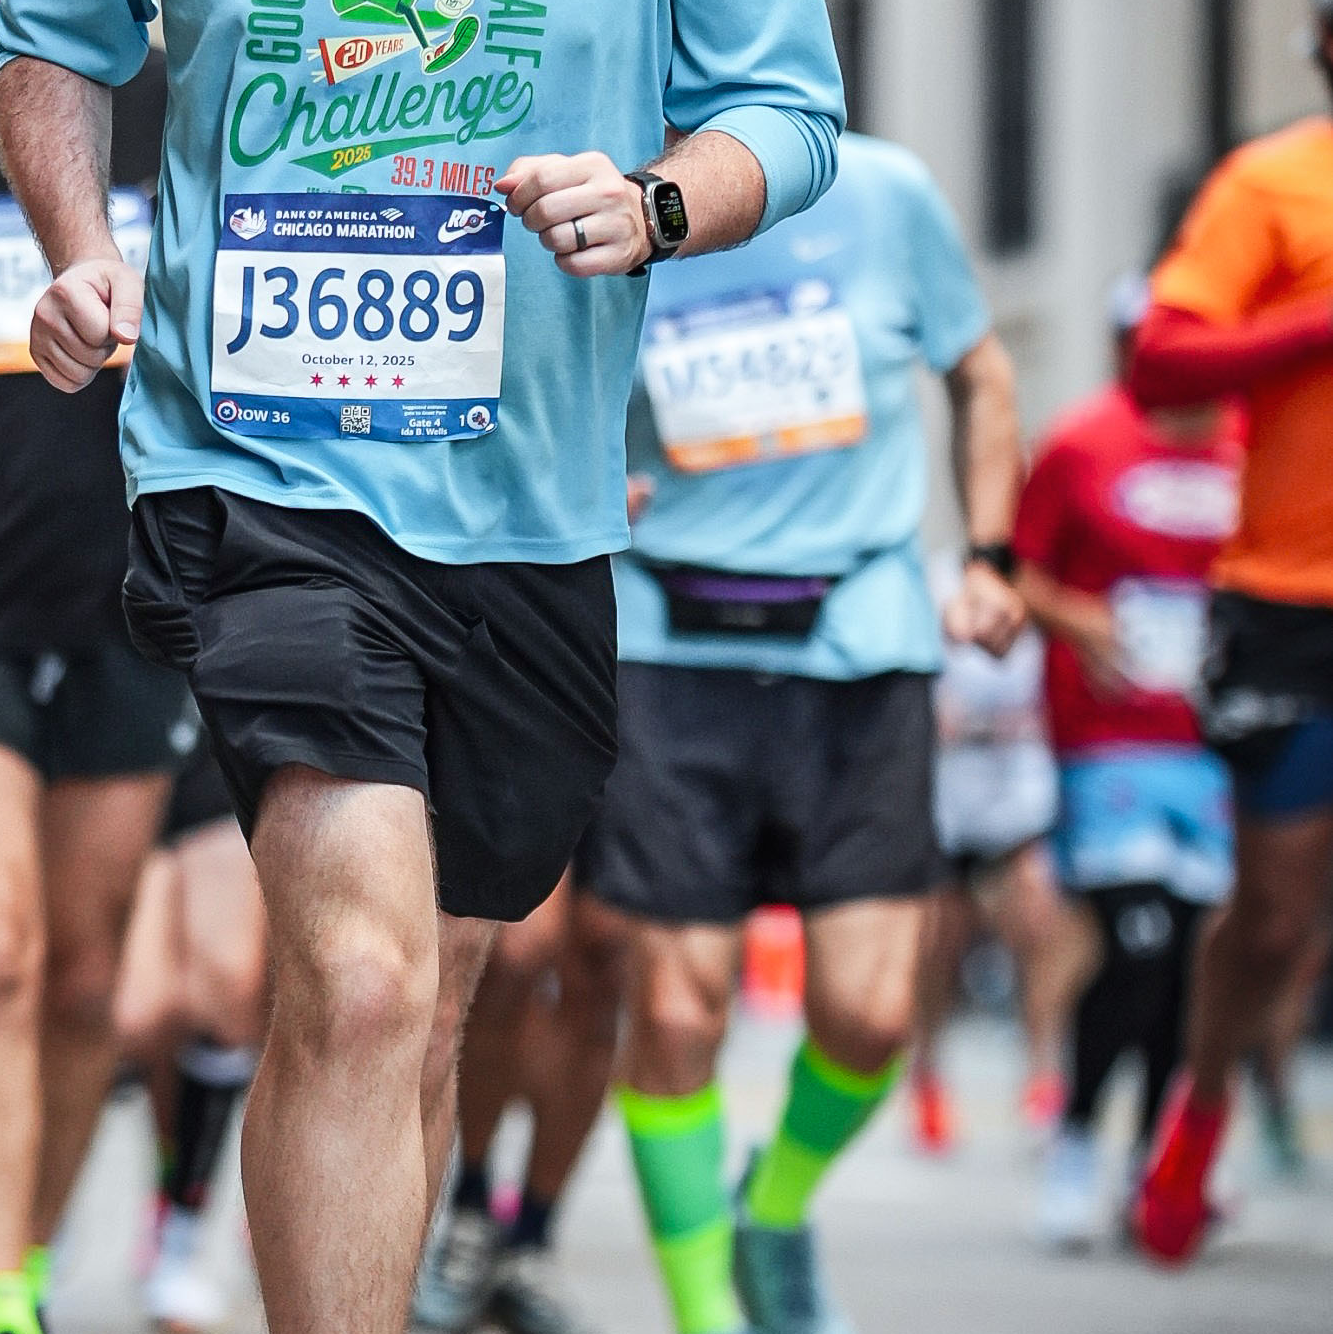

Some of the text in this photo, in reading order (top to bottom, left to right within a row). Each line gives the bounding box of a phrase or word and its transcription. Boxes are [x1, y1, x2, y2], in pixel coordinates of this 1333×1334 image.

[343, 38, 404, 67] 20 YEARS
[229, 69, 534, 167] Challenge
[330, 145, 372, 171] 2025
[391, 155, 495, 196] 39.3 MILES
[275, 210, 378, 221] BANK OF AMERICA
[273, 222, 416, 239] CHICAGO MARATHON
[226, 266, 485, 356] J36889
[301, 353, 416, 368] October 12, 2025
[271, 410, 291, 424] 36
[408, 418, 441, 428] Gate 4
[400, 427, 448, 436] Ida B. Wells
